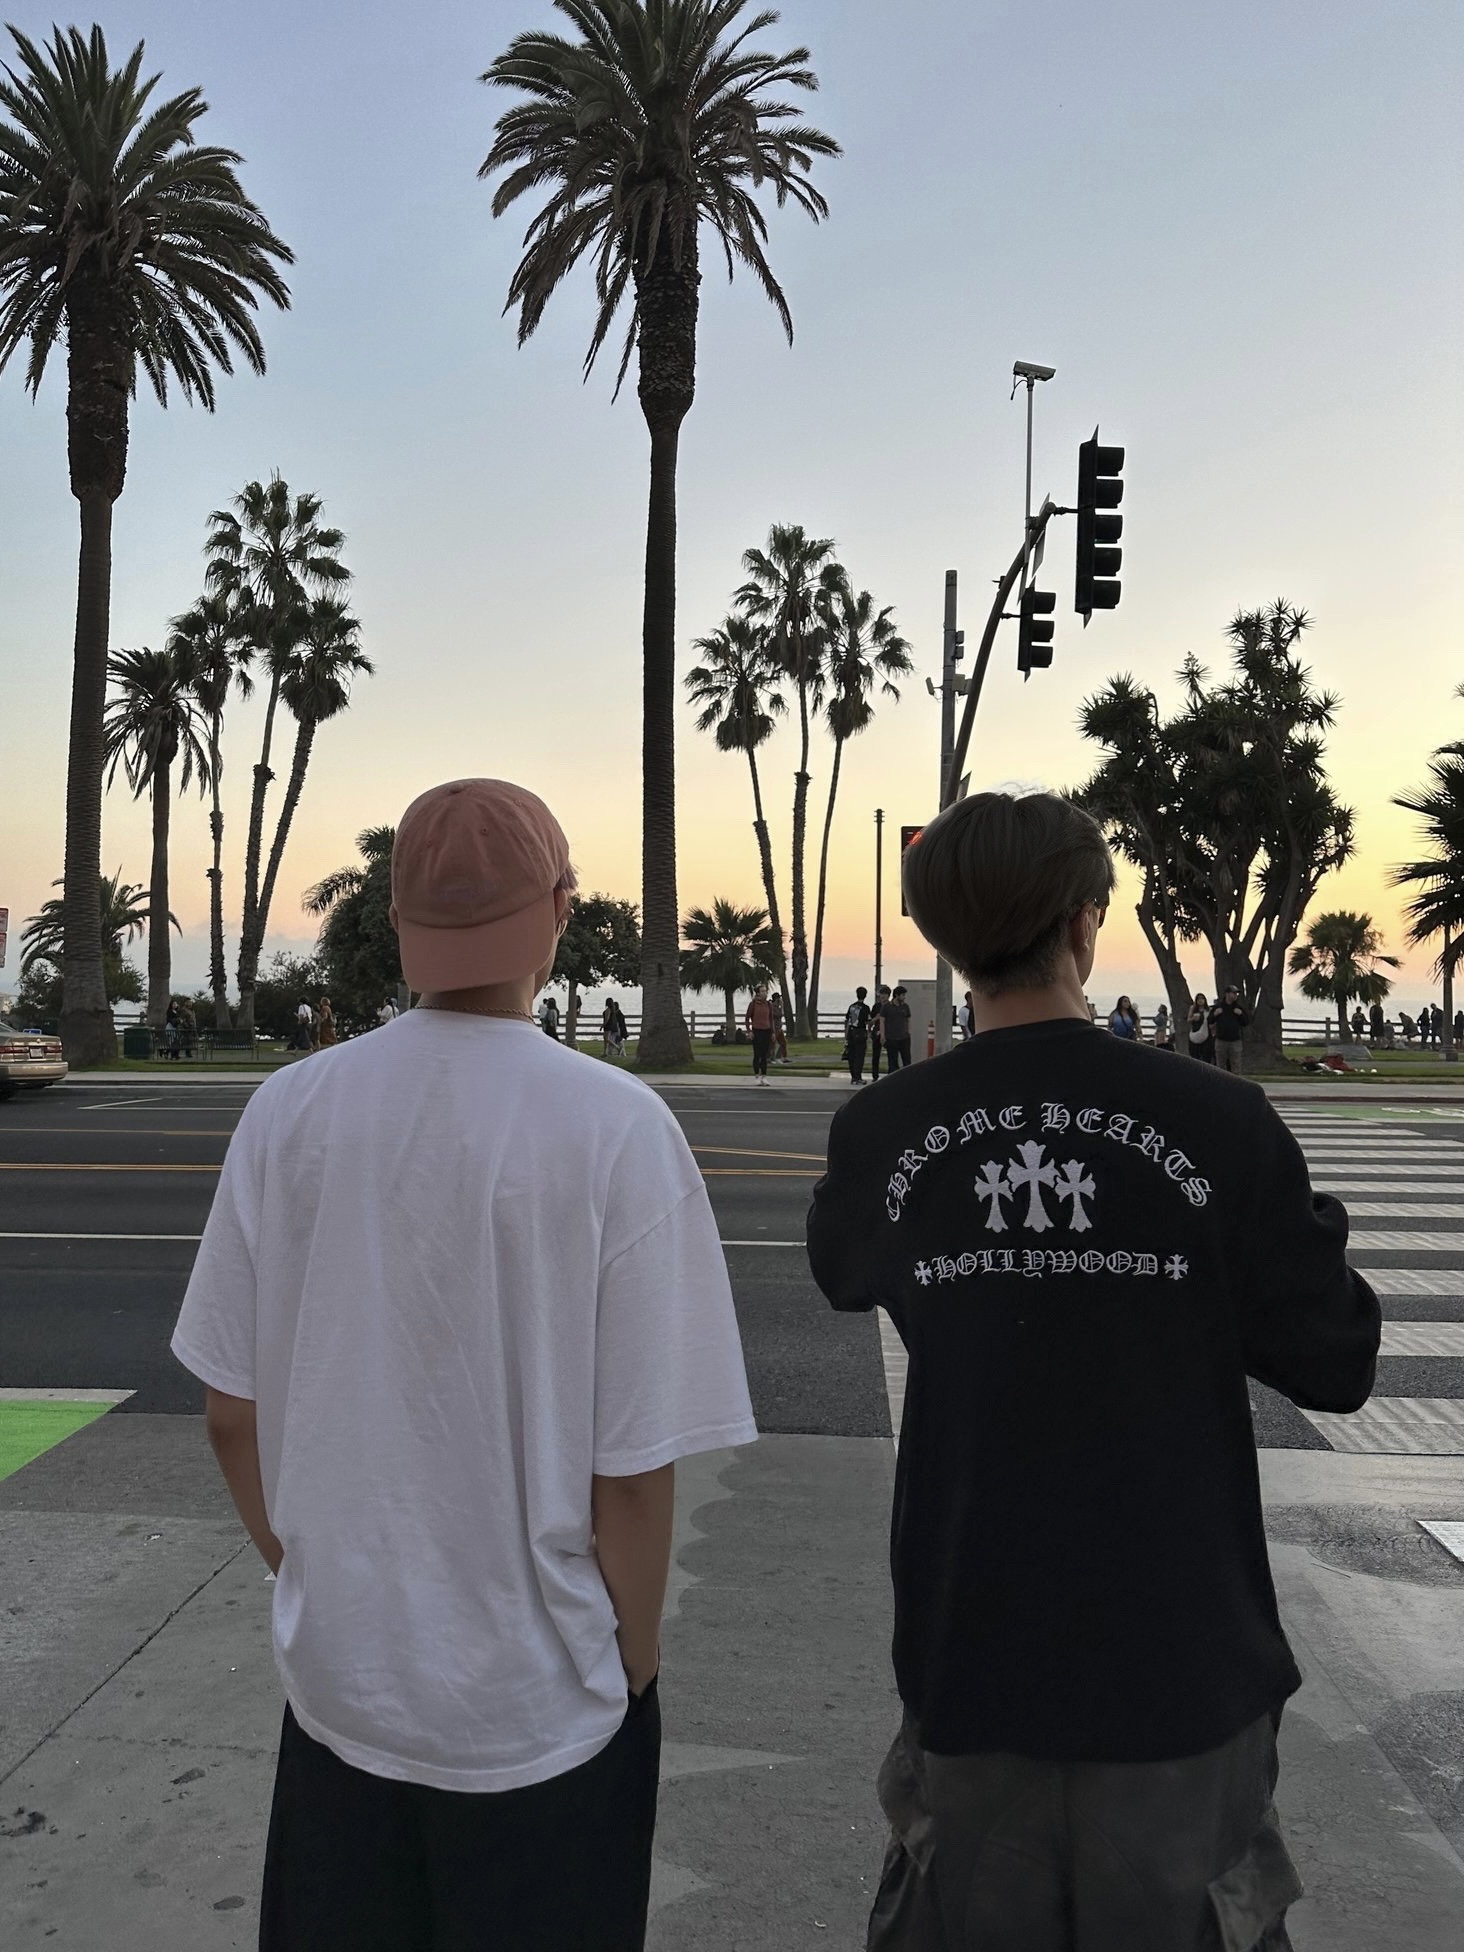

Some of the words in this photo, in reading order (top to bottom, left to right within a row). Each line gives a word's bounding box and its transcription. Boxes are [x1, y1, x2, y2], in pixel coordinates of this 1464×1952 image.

[886, 1106, 1026, 1222] CHROME
[1041, 1102, 1212, 1206] HEARTS
[932, 1249, 1158, 1284] HOLLYWOOD
